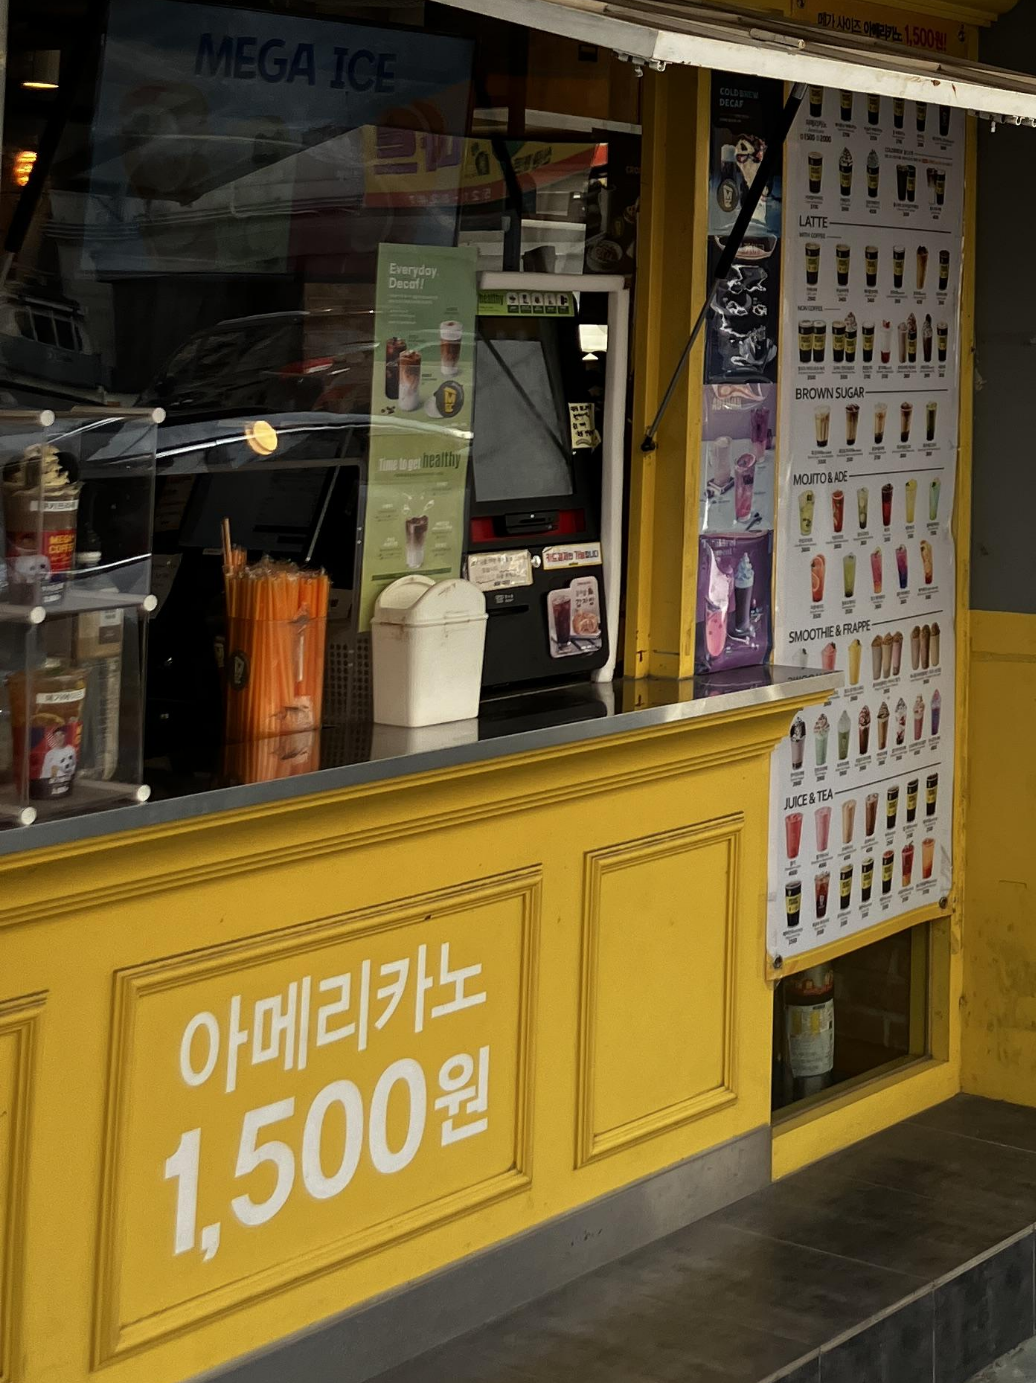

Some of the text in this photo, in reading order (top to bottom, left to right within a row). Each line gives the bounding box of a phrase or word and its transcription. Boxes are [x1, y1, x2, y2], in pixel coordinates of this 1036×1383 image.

[818, 12, 835, 27] 메가
[837, 16, 862, 34] 사이즈
[904, 24, 948, 52] 1,500원!
[195, 32, 397, 94] MEGA ICE
[719, 98, 744, 108] DECAF
[800, 216, 828, 229] LATTE
[388, 277, 425, 290] Decaf!
[795, 386, 865, 400] BROWN SUGAR
[423, 451, 461, 469] healthy
[793, 471, 848, 485] MOJITO & ADE
[788, 620, 871, 644] SMOOTHIE & FRAPPE
[784, 788, 834, 811] JUICE & TEA
[179, 941, 487, 1094] 아메리카노
[164, 1044, 490, 1262] 1,500원
